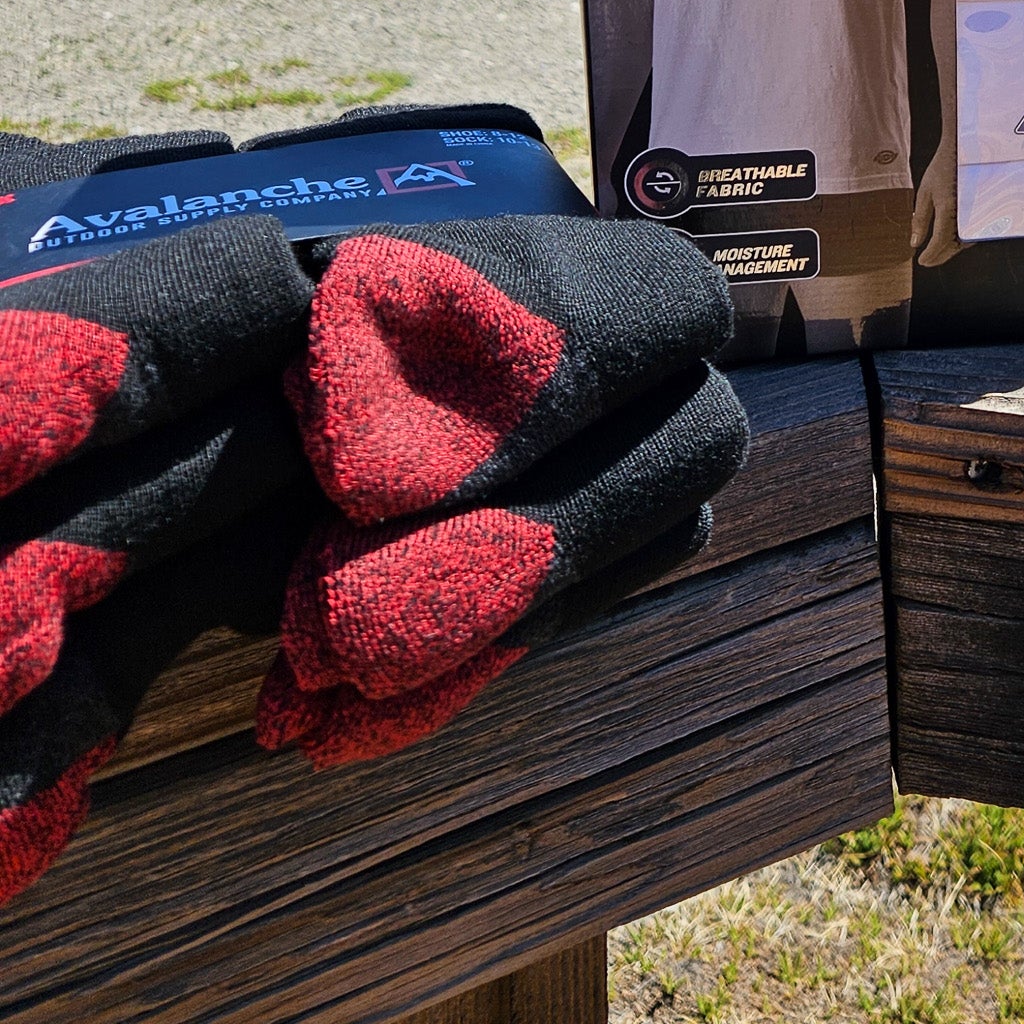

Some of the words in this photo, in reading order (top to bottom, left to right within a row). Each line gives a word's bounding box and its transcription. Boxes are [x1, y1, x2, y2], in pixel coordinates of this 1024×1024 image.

[698, 163, 808, 183] BREATHABLE
[696, 182, 764, 199] FABRIC
[30, 176, 369, 242] Avalanche
[28, 221, 147, 253] OUTDOOR
[158, 203, 248, 226] SUPPLY
[259, 188, 372, 208] COMPANY
[712, 244, 794, 262] MOISTURE
[717, 257, 810, 276] NAGEMENT
